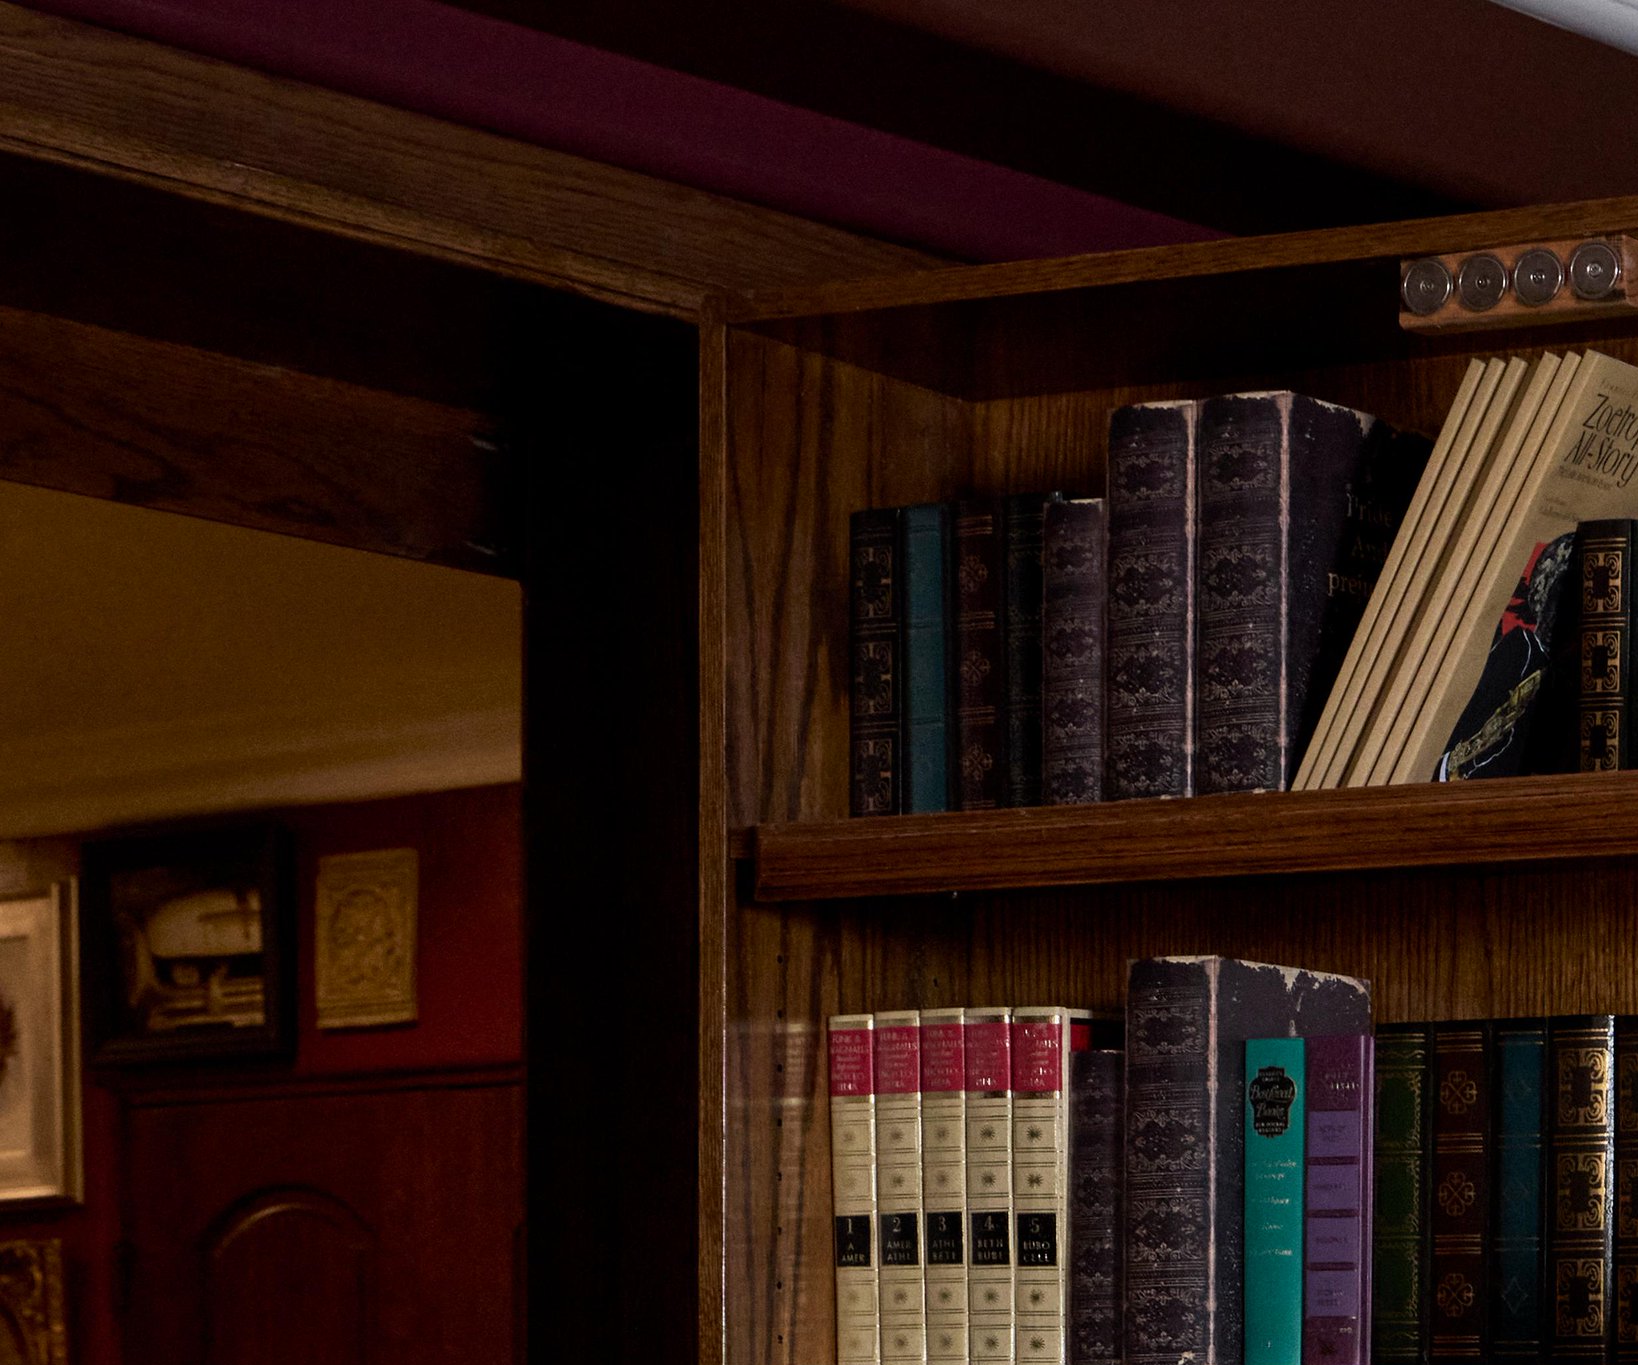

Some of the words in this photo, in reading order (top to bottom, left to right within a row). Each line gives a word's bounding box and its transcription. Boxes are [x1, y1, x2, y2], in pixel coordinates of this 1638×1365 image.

[847, 1218, 854, 1236] 1
[892, 1217, 902, 1233] 2
[938, 1216, 947, 1232] 3
[985, 1215, 996, 1232] 4
[1029, 1217, 1041, 1234] 5
[841, 1253, 866, 1264] AMER
